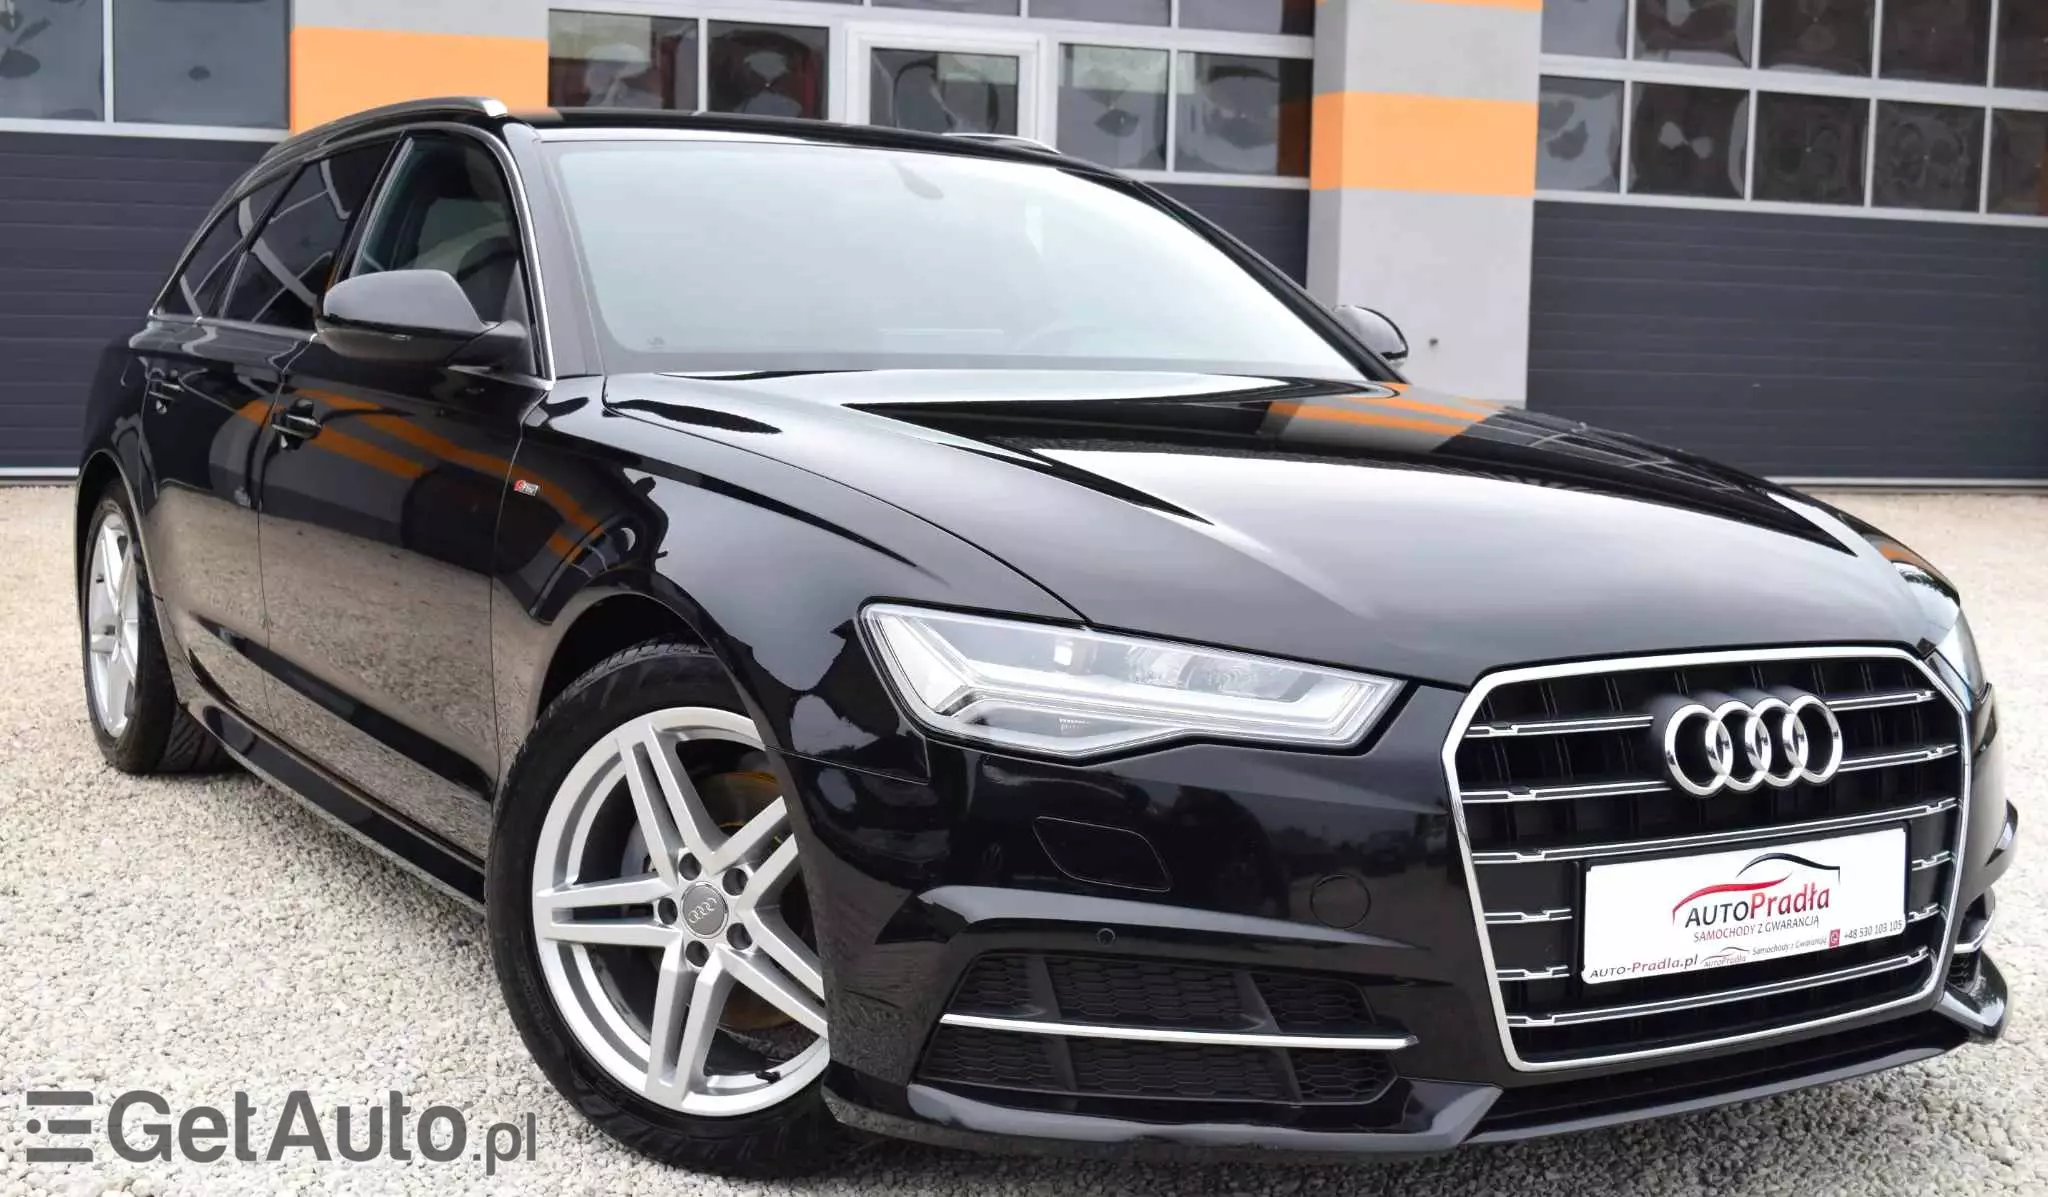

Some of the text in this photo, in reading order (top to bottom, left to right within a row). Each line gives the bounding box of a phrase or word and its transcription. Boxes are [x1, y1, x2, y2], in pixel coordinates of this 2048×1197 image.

[1685, 882, 1830, 928] AUTOPradła
[1693, 915, 1820, 943] SAMOCHODY Z GWARANCJĄ
[1844, 919, 1903, 939] +48 530 103 105
[1590, 953, 1699, 978] AUTO-Pradla.pl
